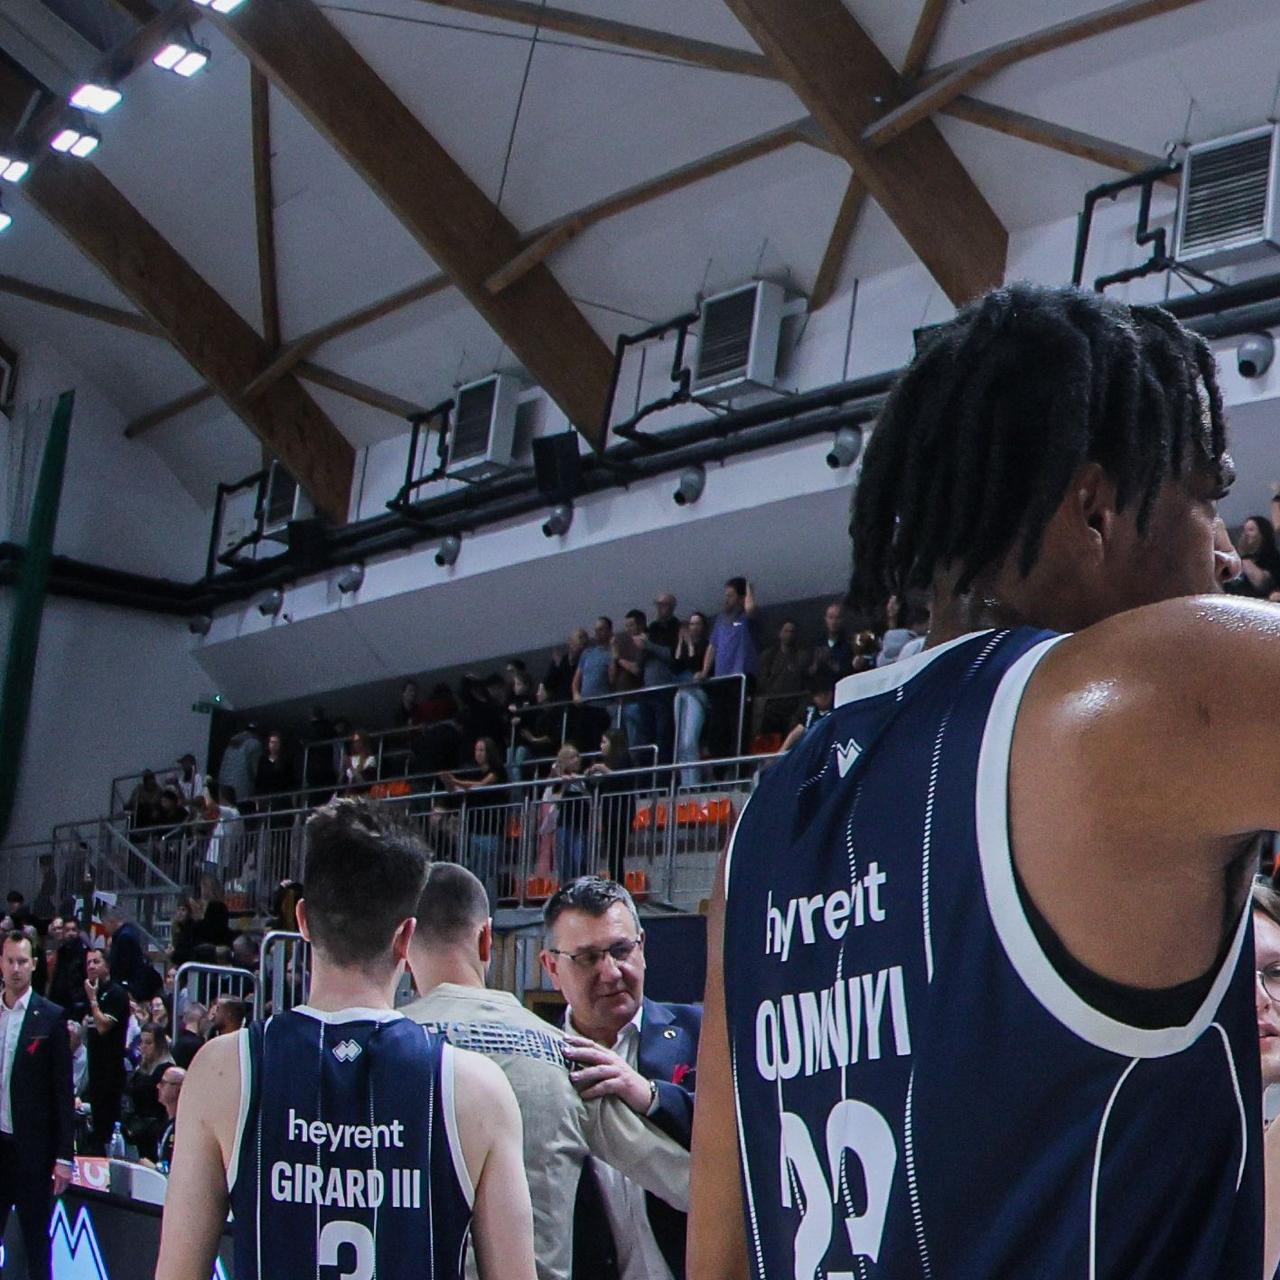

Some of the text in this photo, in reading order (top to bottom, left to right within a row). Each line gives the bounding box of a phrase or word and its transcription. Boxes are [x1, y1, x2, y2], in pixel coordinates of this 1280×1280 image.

[288, 1108, 404, 1152] heyrent
[271, 1160, 421, 1209] GIRARD III
